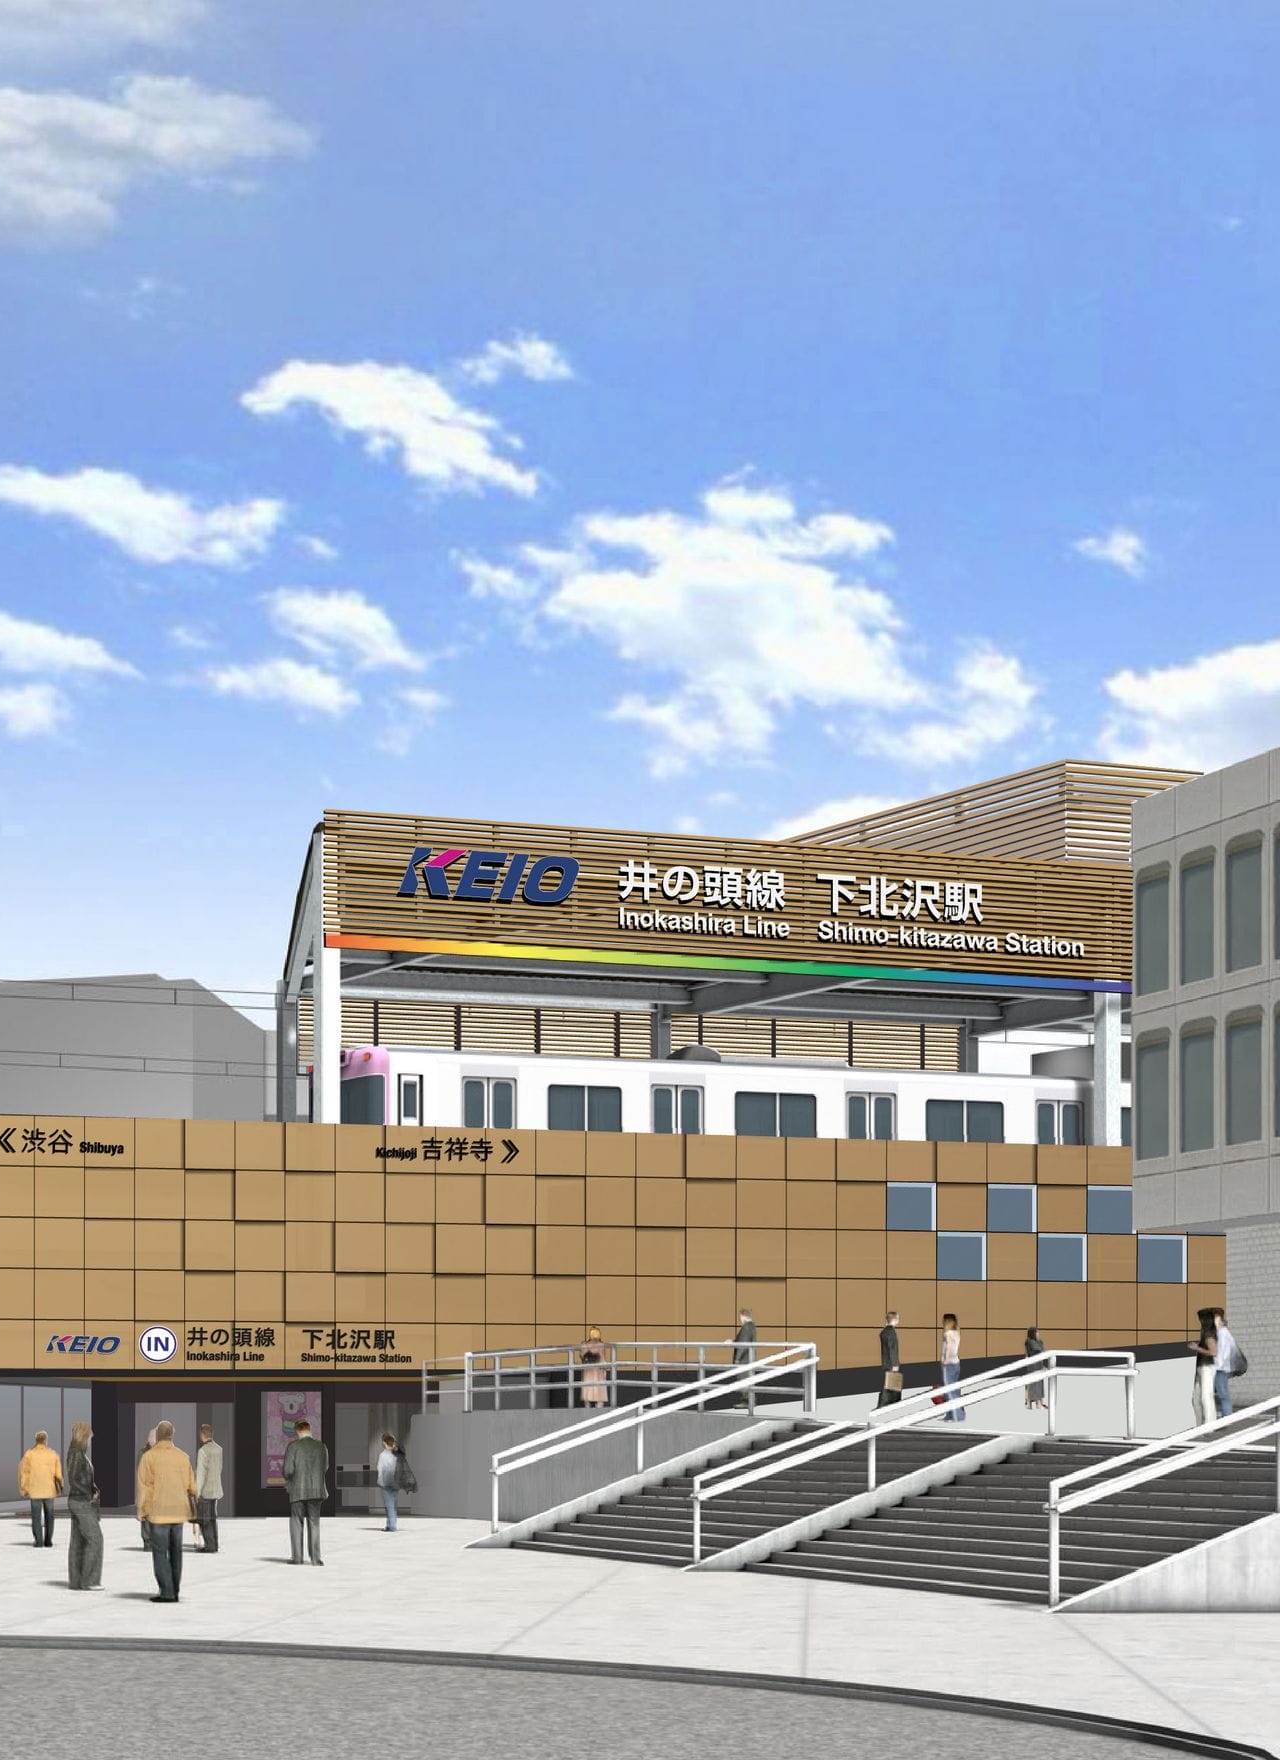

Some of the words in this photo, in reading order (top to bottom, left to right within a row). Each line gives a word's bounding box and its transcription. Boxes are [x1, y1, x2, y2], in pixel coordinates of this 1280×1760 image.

[396, 846, 580, 906] KEIO
[619, 860, 786, 909] 井の頭線
[817, 873, 984, 923] 下北沢駅
[619, 907, 736, 934] Inokashira
[744, 914, 790, 939] Line
[818, 920, 998, 951] Shimo-kitazawa
[1005, 932, 1085, 958] Station
[21, 1128, 73, 1155] 渋谷
[79, 1141, 124, 1156] Shibuya
[375, 1147, 418, 1161] Kichijoji
[421, 1137, 493, 1162] 吉祥寺
[46, 1335, 121, 1354] KEIO
[146, 1336, 170, 1352] IN
[187, 1327, 276, 1348] 井の頭線
[302, 1329, 396, 1350] 下北沢駅
[186, 1351, 240, 1362] Inokashira
[243, 1352, 265, 1362] Line
[301, 1352, 377, 1363] Shimo-kitazawa
[379, 1353, 412, 1363] Station
